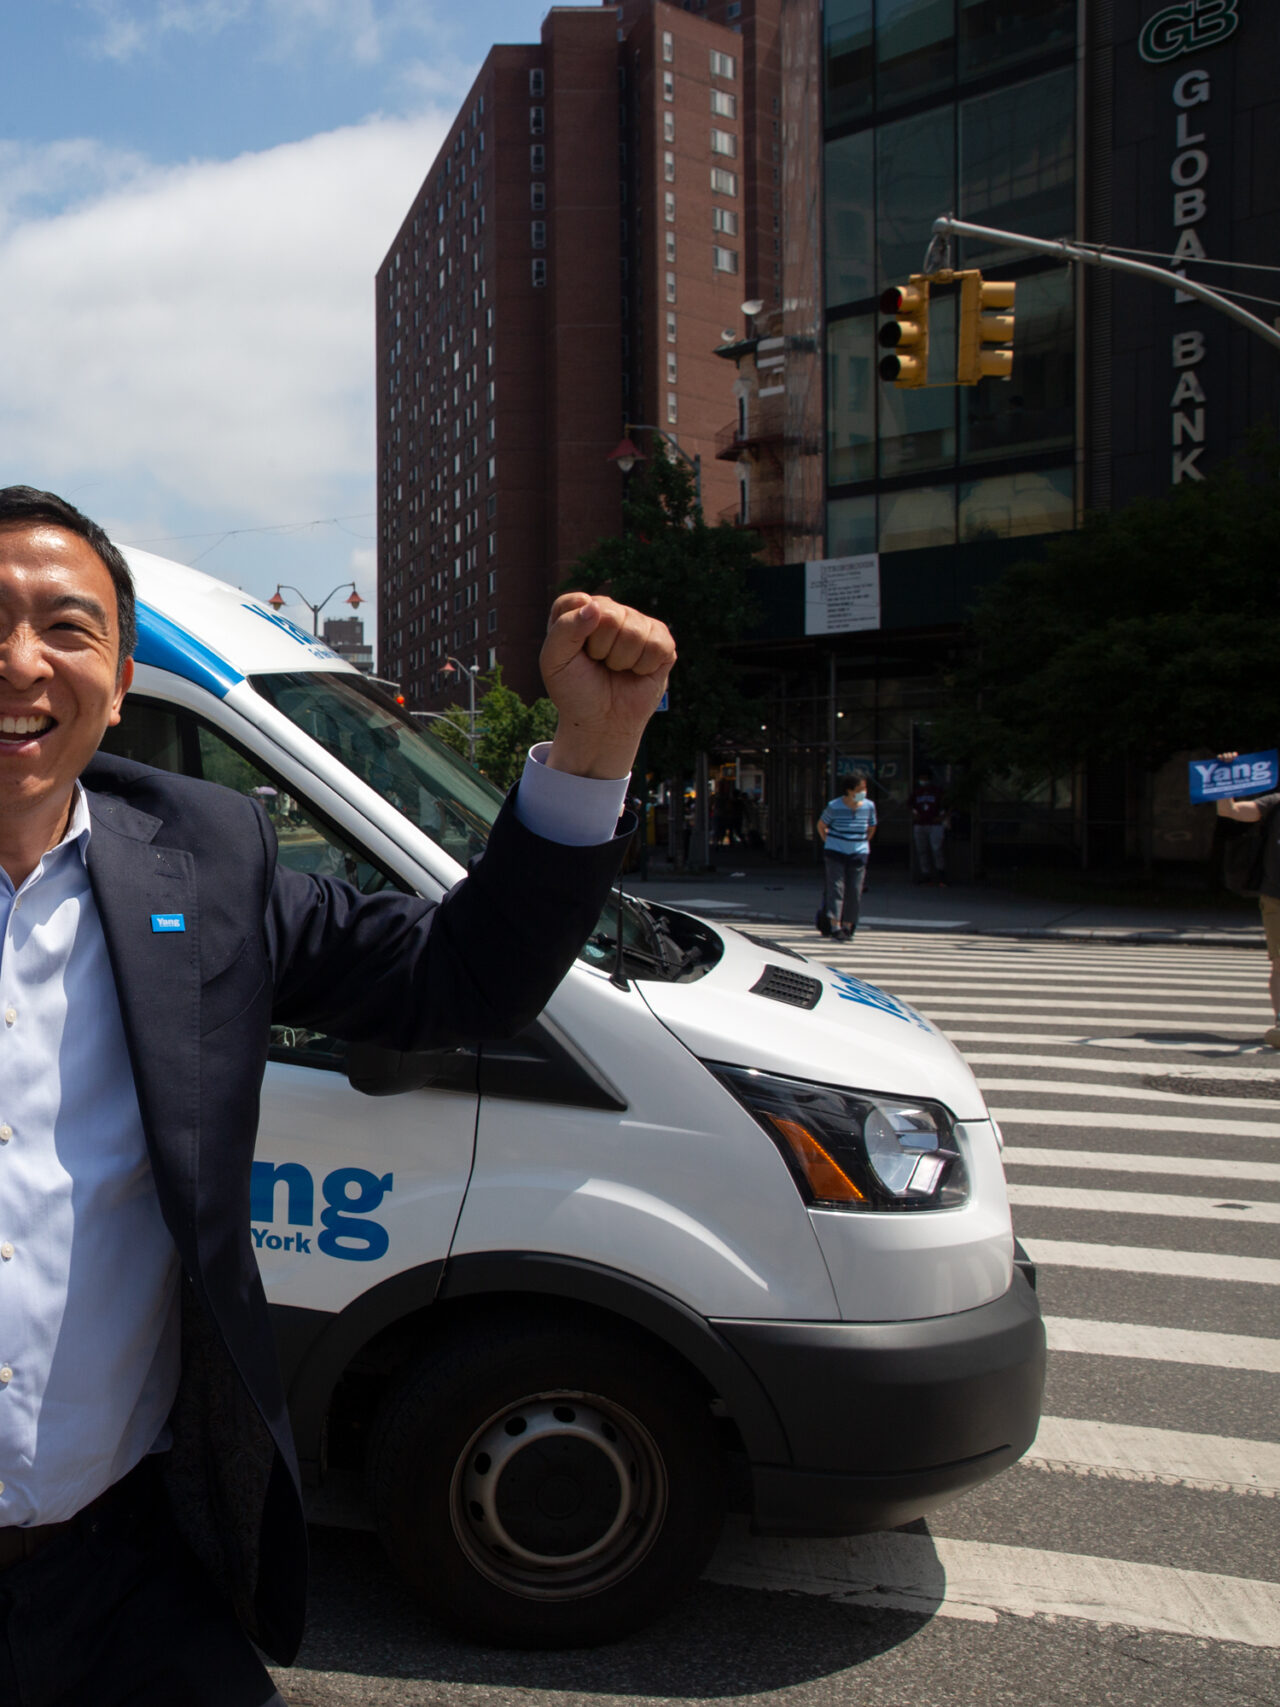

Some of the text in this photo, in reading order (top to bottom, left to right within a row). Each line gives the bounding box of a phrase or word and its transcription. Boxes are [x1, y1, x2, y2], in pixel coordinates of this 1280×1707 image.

[1169, 69, 1211, 486] GLOBAL BANK
[1194, 760, 1272, 783] Yang
[250, 1160, 393, 1262] ng
[251, 1228, 311, 1254] York
